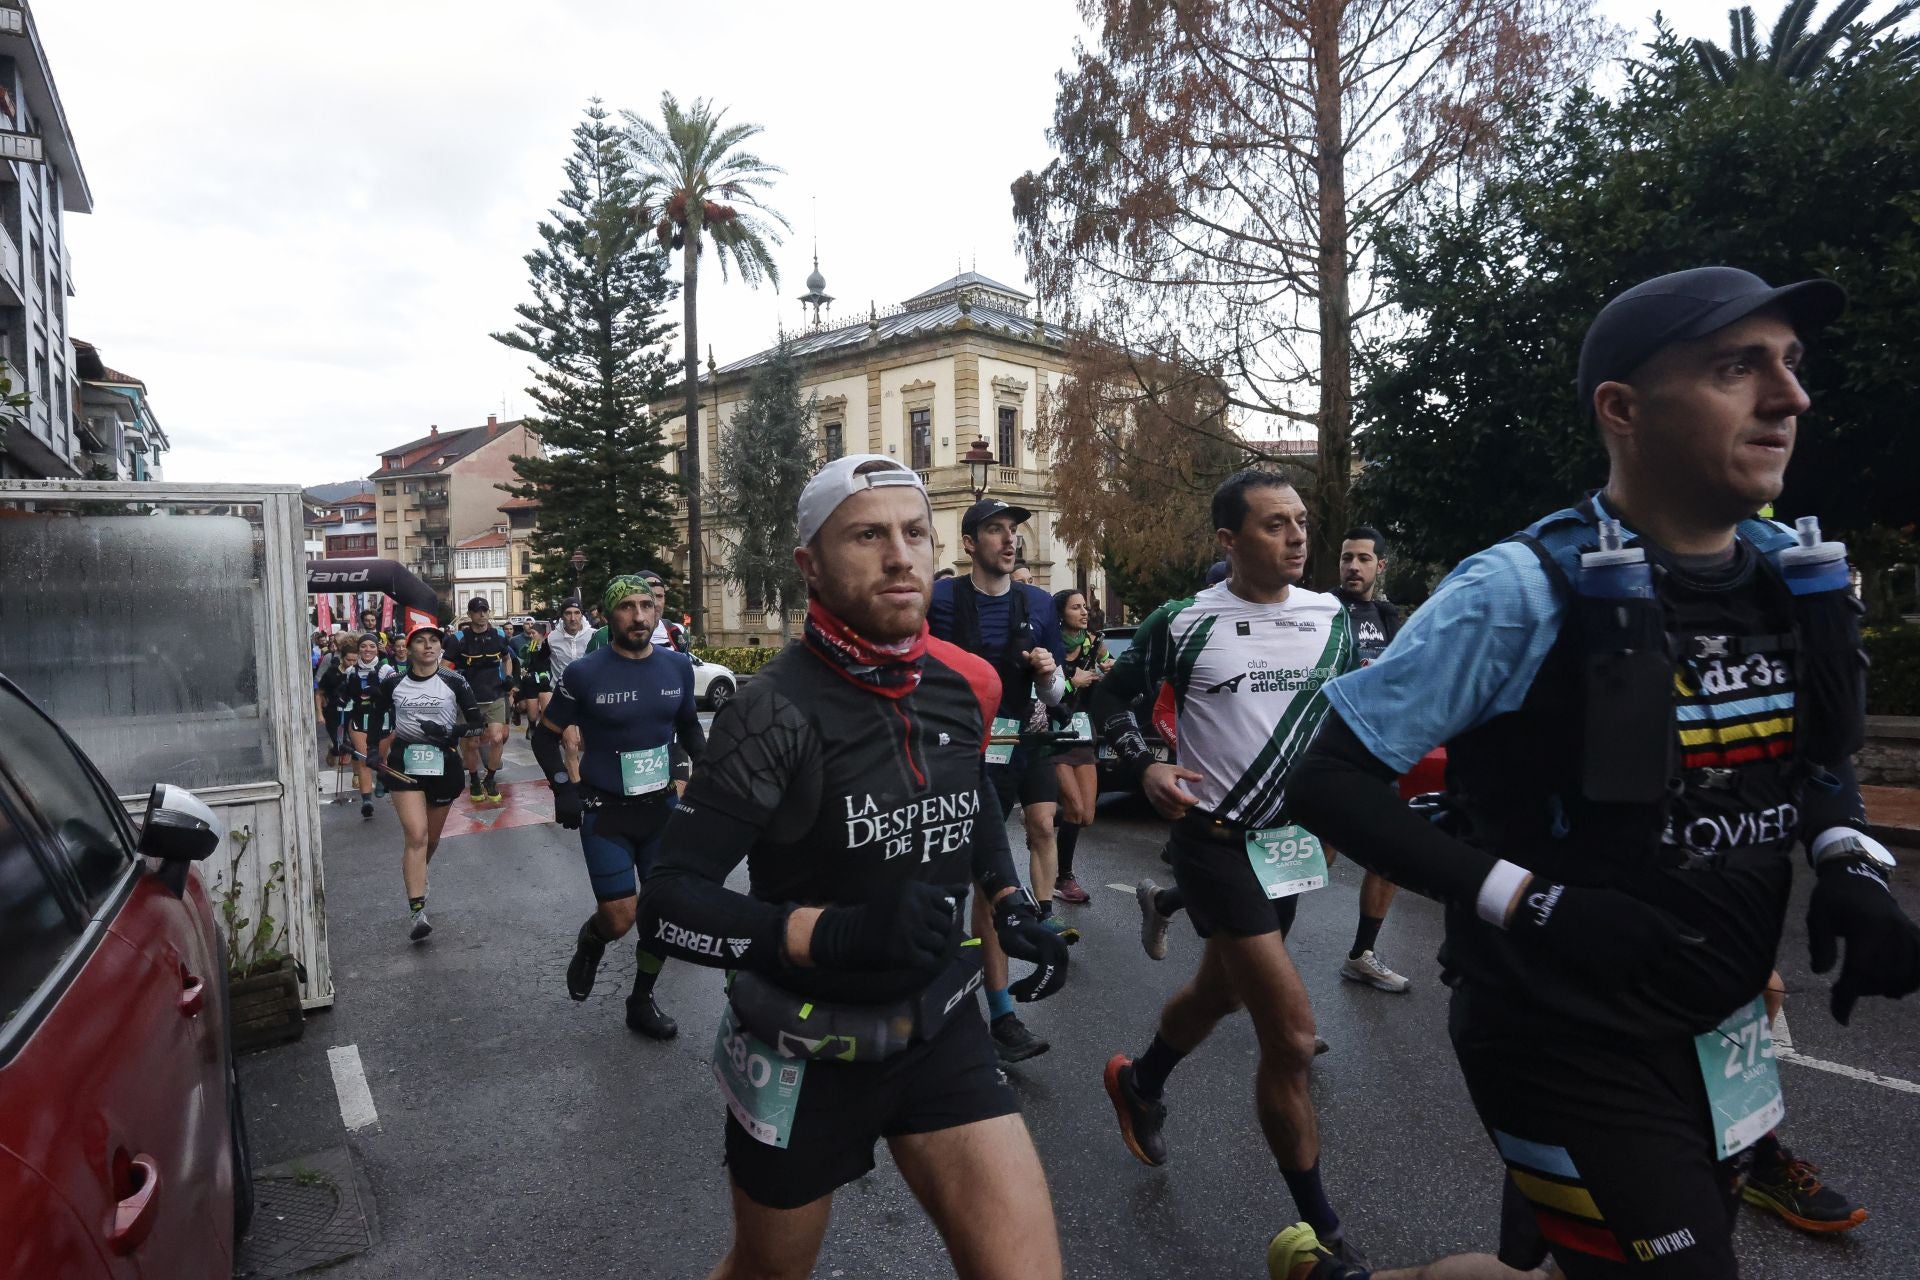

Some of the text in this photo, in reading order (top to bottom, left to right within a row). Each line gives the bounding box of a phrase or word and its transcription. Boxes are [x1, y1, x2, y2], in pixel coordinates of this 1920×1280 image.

[1247, 660, 1267, 668] club
[1250, 680, 1319, 693] atletismo
[411, 750, 435, 761] 319
[633, 756, 664, 774] 324
[844, 793, 879, 819] LA
[845, 789, 980, 849] DESPENSA
[884, 833, 913, 861] DE
[1264, 836, 1314, 864] 395
[1275, 860, 1303, 869] SANTOS
[654, 917, 724, 957] TERREX
[726, 937, 752, 945] adidas
[1719, 1013, 1777, 1080] 275
